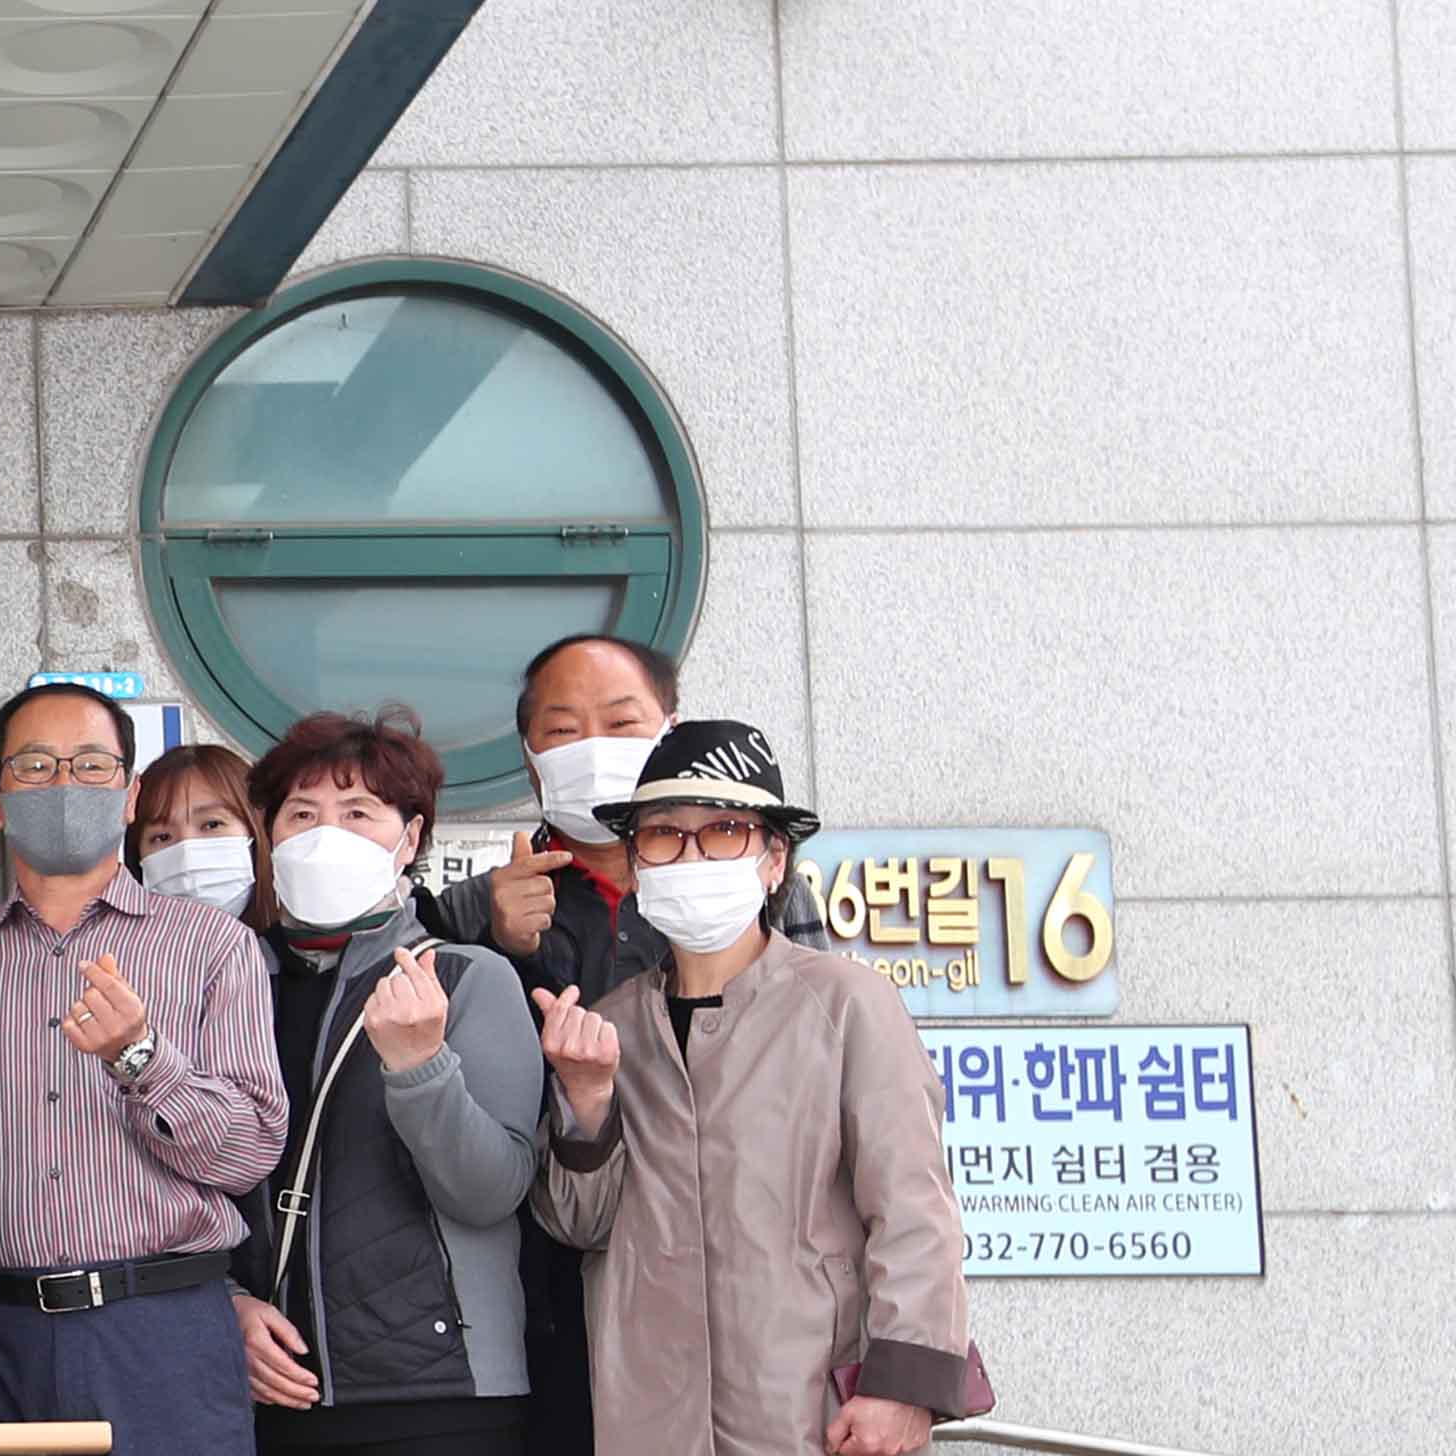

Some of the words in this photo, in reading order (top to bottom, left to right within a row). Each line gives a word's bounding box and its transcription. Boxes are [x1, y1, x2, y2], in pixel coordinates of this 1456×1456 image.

[989, 853, 1115, 985] 16
[1126, 1193, 1157, 1211] AIR
[1162, 1192, 1244, 1213] CENTER)
